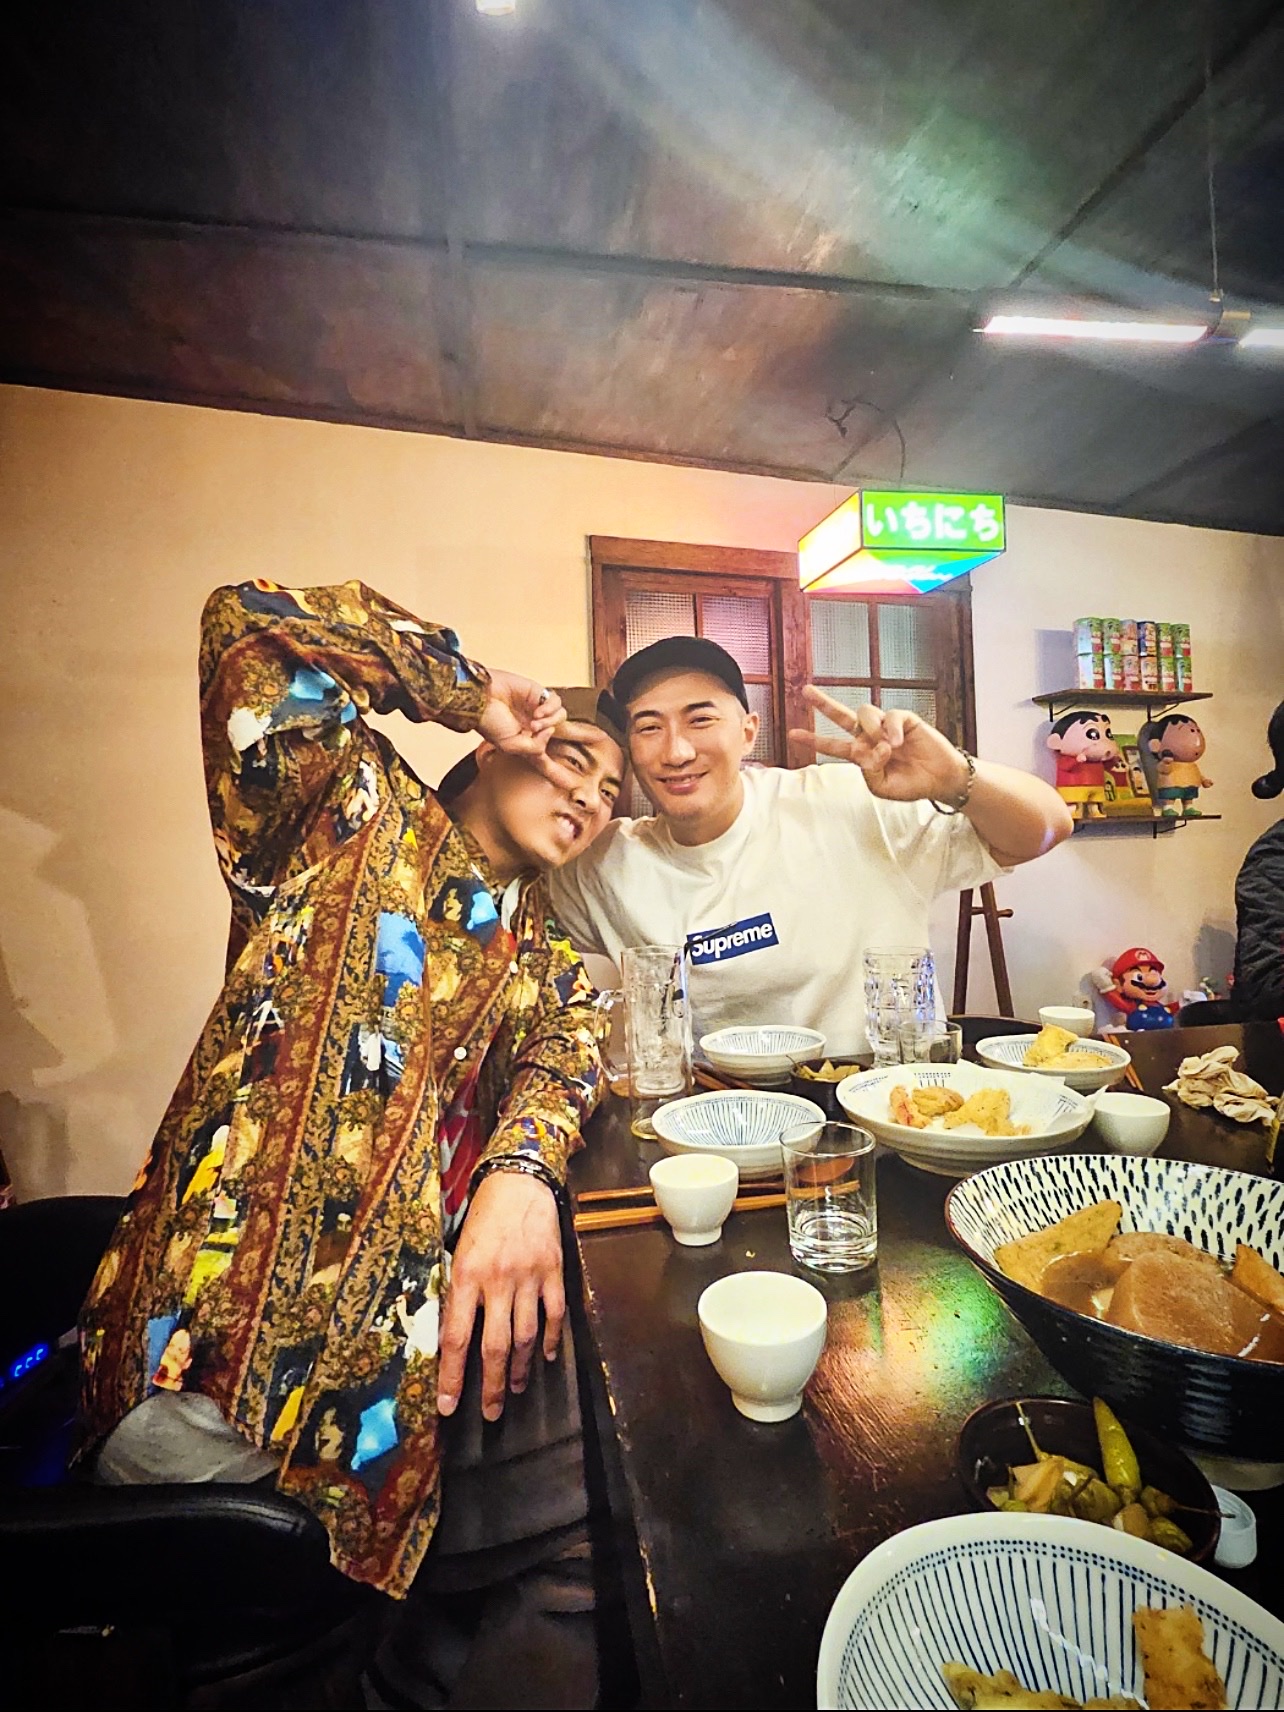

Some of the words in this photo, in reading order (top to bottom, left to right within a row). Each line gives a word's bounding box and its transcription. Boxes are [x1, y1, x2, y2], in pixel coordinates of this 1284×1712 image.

[866, 501, 999, 541] いちにち
[692, 923, 773, 959] Supreme
[1137, 951, 1150, 960] M
